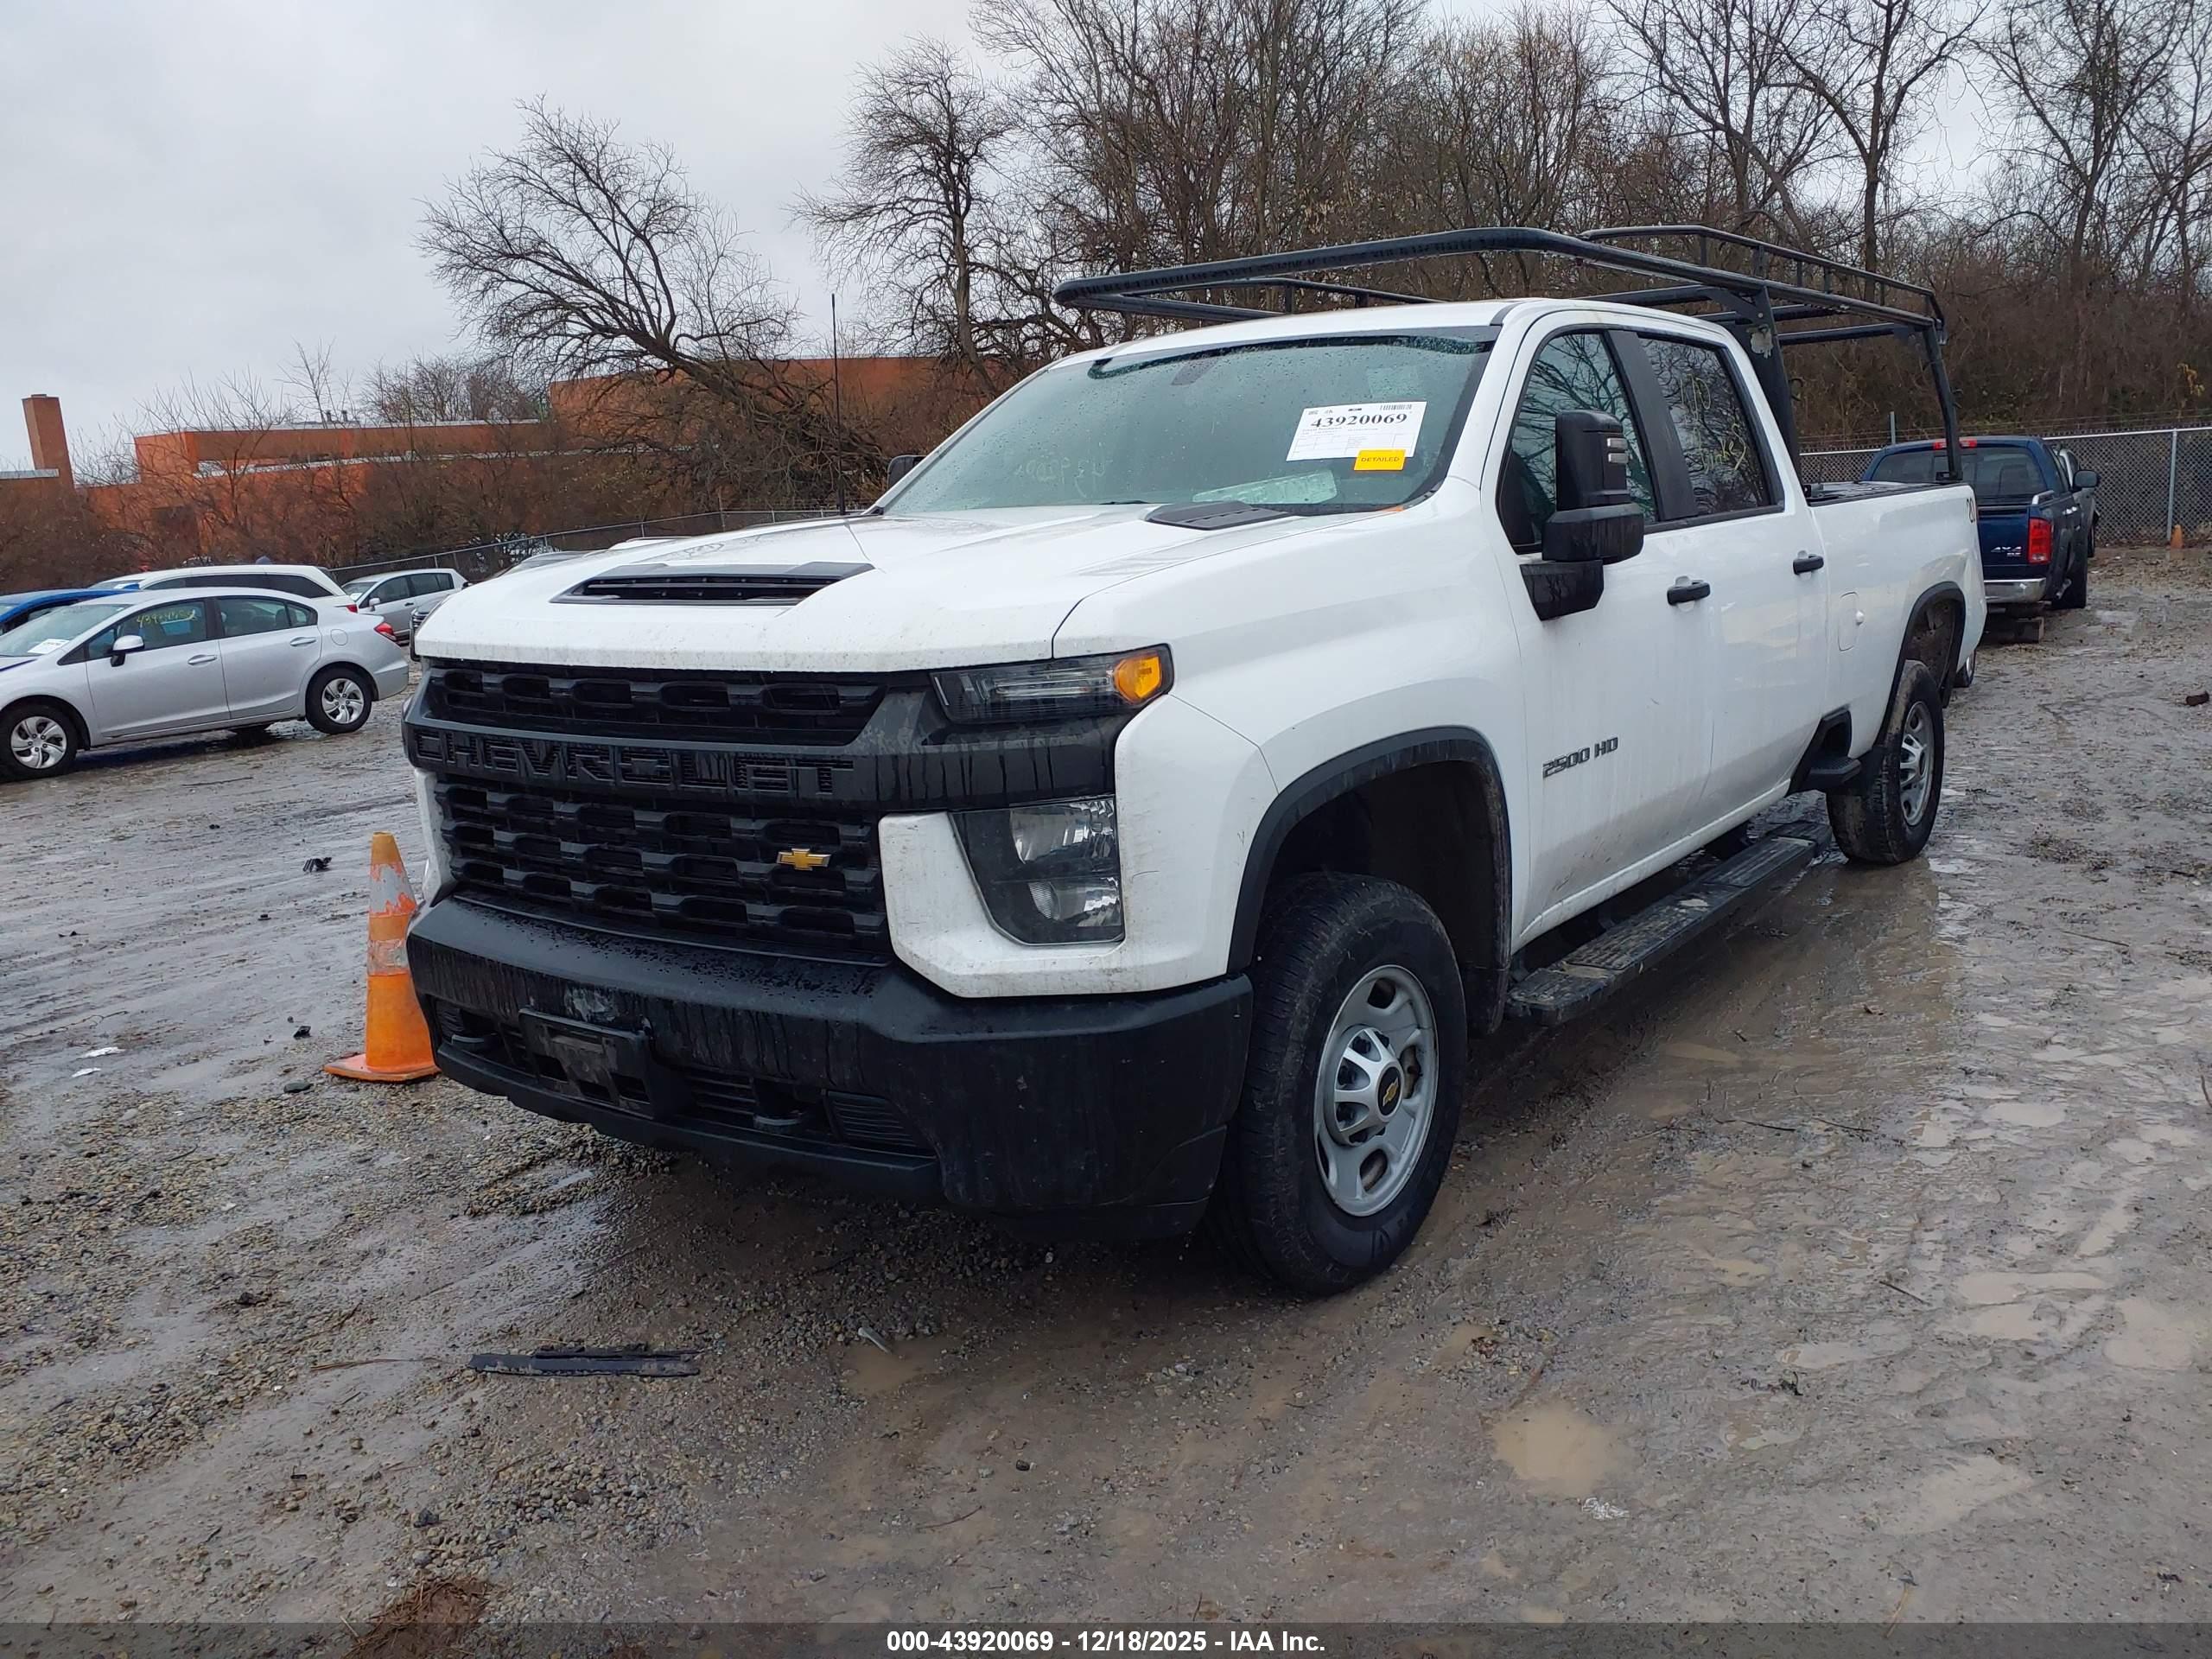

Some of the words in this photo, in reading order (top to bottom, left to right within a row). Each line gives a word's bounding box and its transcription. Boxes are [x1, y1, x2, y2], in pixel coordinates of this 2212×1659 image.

[1310, 413, 1408, 428] 43920069
[416, 728, 855, 795] CHEVROLET
[1542, 747, 1591, 779] 2500
[1594, 736, 1618, 758] HD
